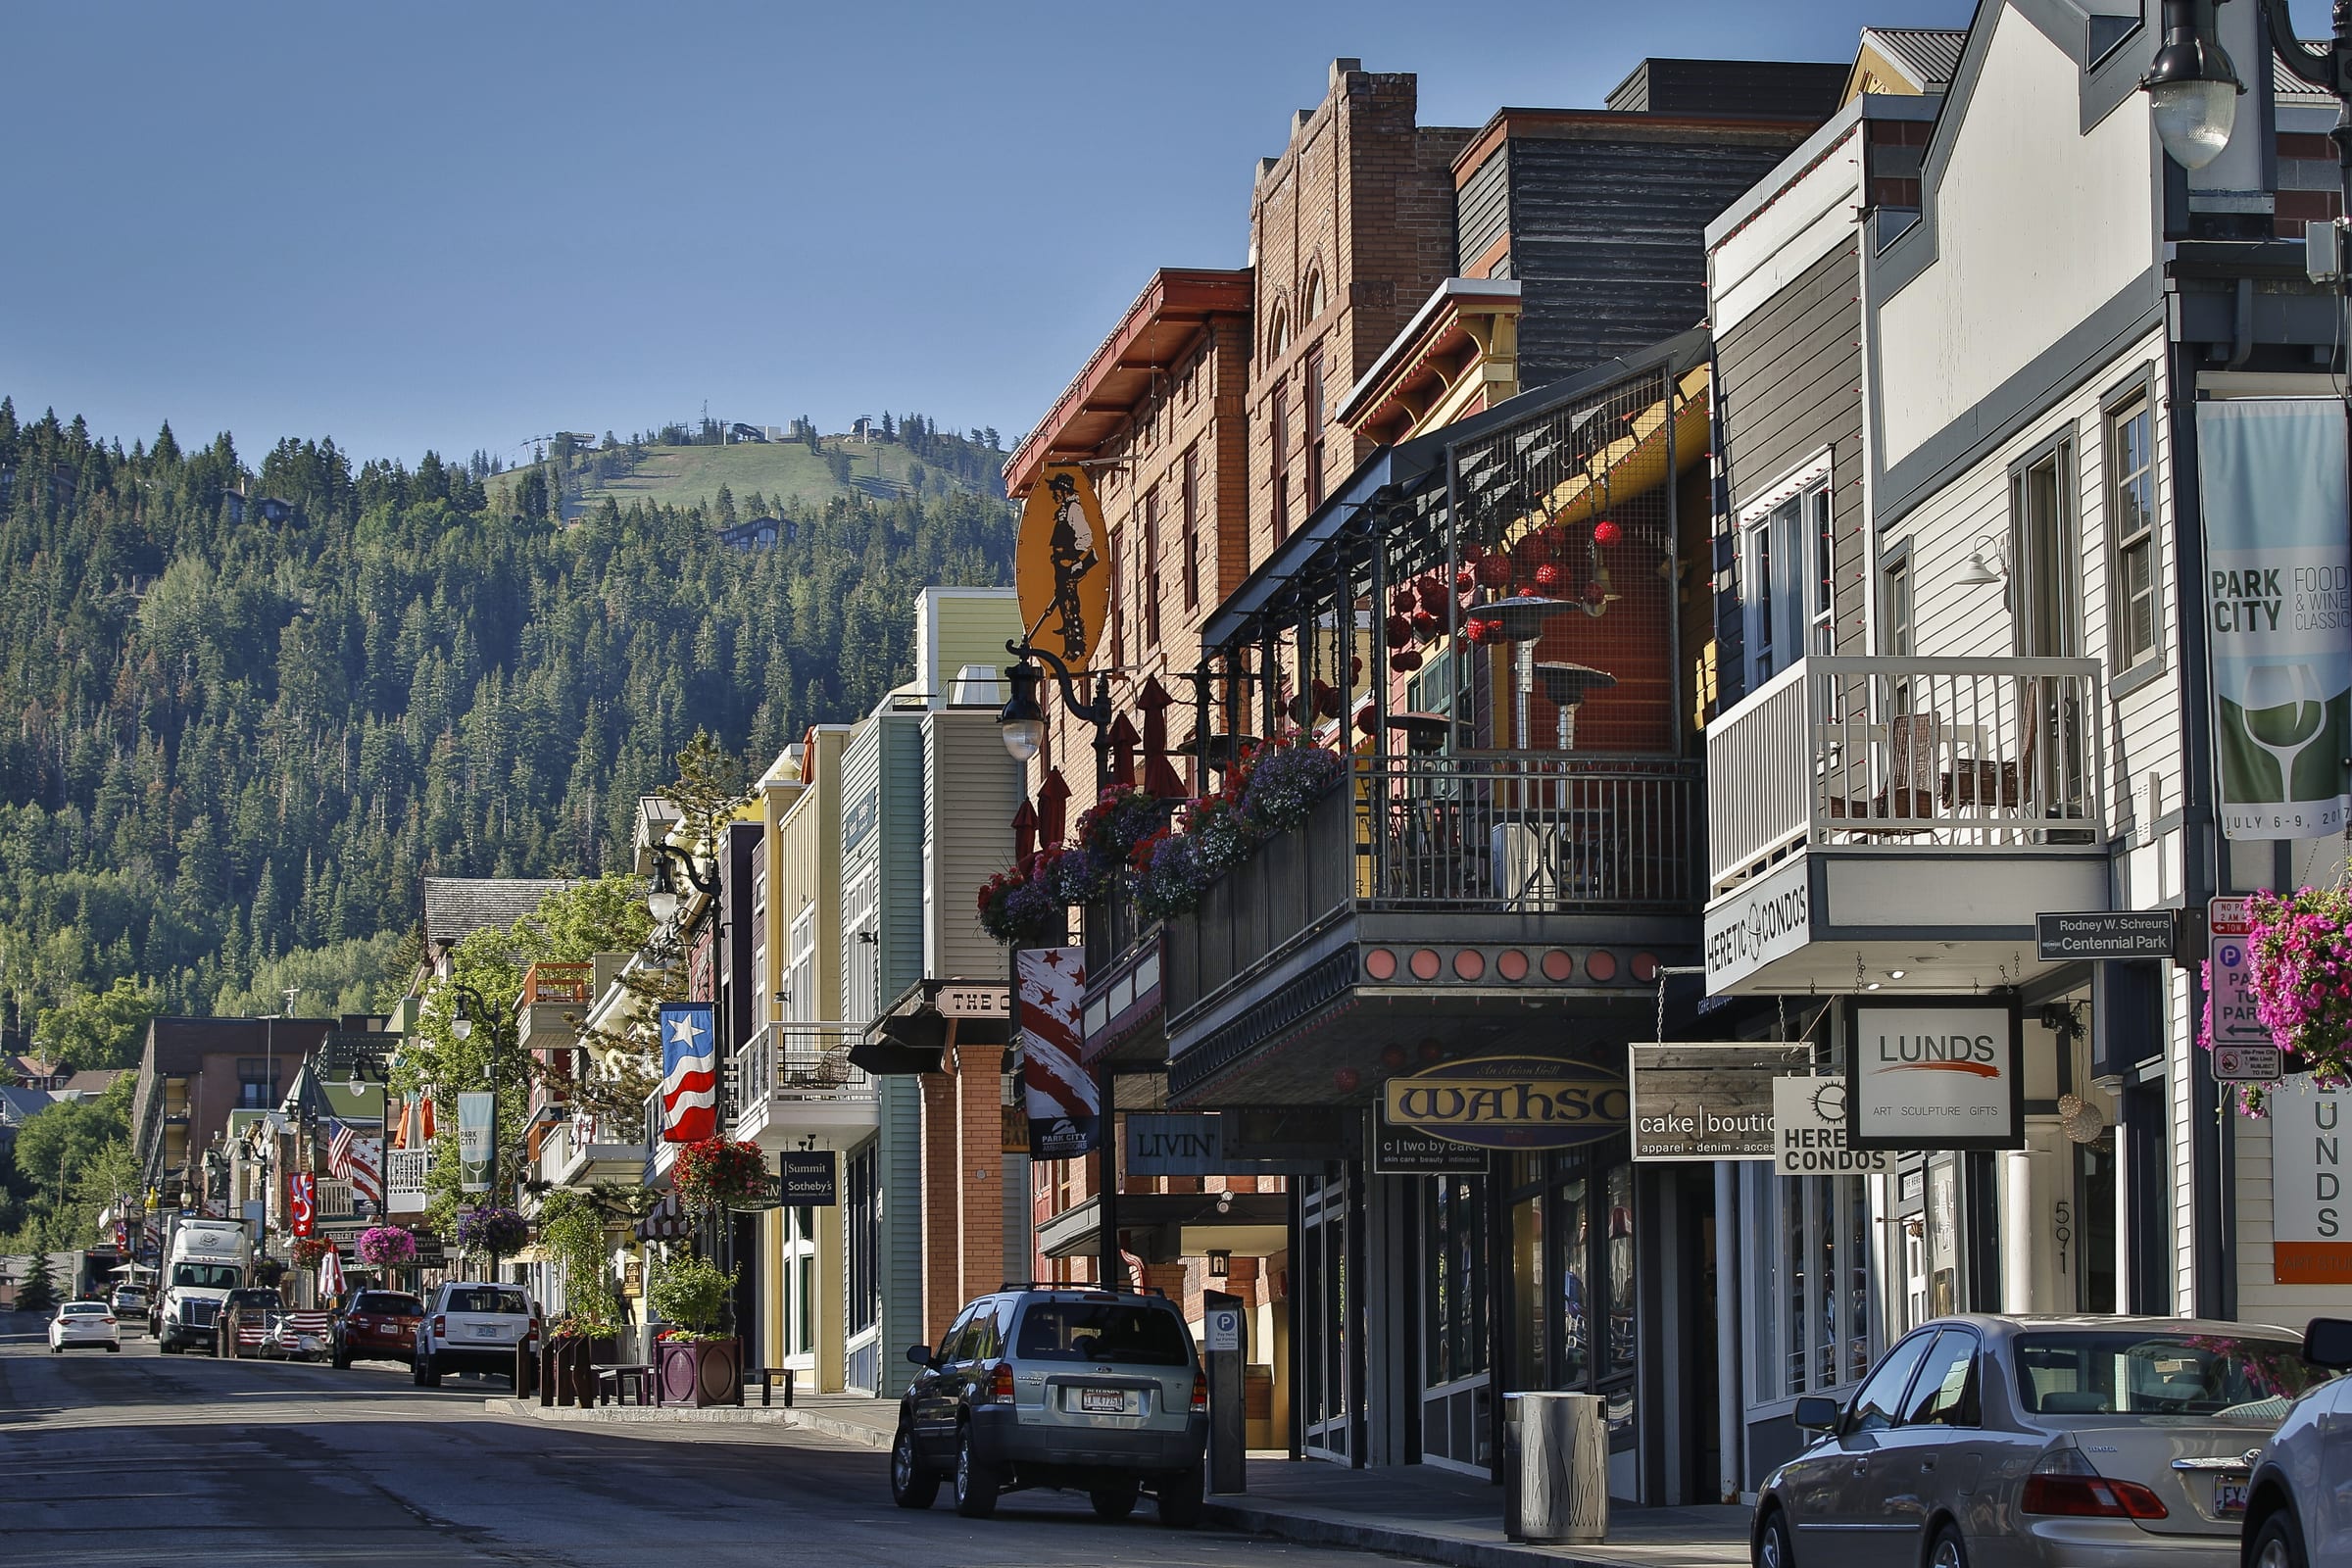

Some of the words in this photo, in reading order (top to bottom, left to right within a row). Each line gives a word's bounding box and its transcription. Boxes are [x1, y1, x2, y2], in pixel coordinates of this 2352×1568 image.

[2211, 568, 2282, 598] PARK
[2294, 565, 2348, 592] FOOD
[2295, 593, 2305, 612] &
[2309, 591, 2350, 611] WINE
[2215, 599, 2281, 633] CITY
[2295, 611, 2350, 631] CLASSIC
[2226, 816, 2262, 829] JULY
[2322, 807, 2350, 825] 2017
[1706, 919, 1747, 975] HERETIC
[1761, 884, 1806, 943] CONDOS
[2059, 919, 2101, 932] Rodney
[2104, 919, 2118, 930] W.
[2120, 918, 2170, 929] Schreurs
[2062, 935, 2133, 950] Centennial
[2136, 935, 2168, 949] Park
[953, 994, 992, 1009] THE
[1880, 1035, 1994, 1062] LUNDS
[1873, 1106, 1892, 1116] ART
[1901, 1106, 1961, 1116] SCULPTURE
[1969, 1106, 1998, 1116] GIFTS
[1640, 1113, 1694, 1133] cake
[1403, 1140, 1426, 1152] two
[1429, 1140, 1446, 1154] by
[1642, 1143, 1684, 1154] apparel
[1696, 1142, 1731, 1152] denim
[1785, 1128, 1846, 1149] HERE
[788, 1163, 825, 1173] Summit
[1785, 1151, 1886, 1171] CONDOS
[788, 1180, 832, 1193] Sotheby's
[2055, 1201, 2071, 1274] 591
